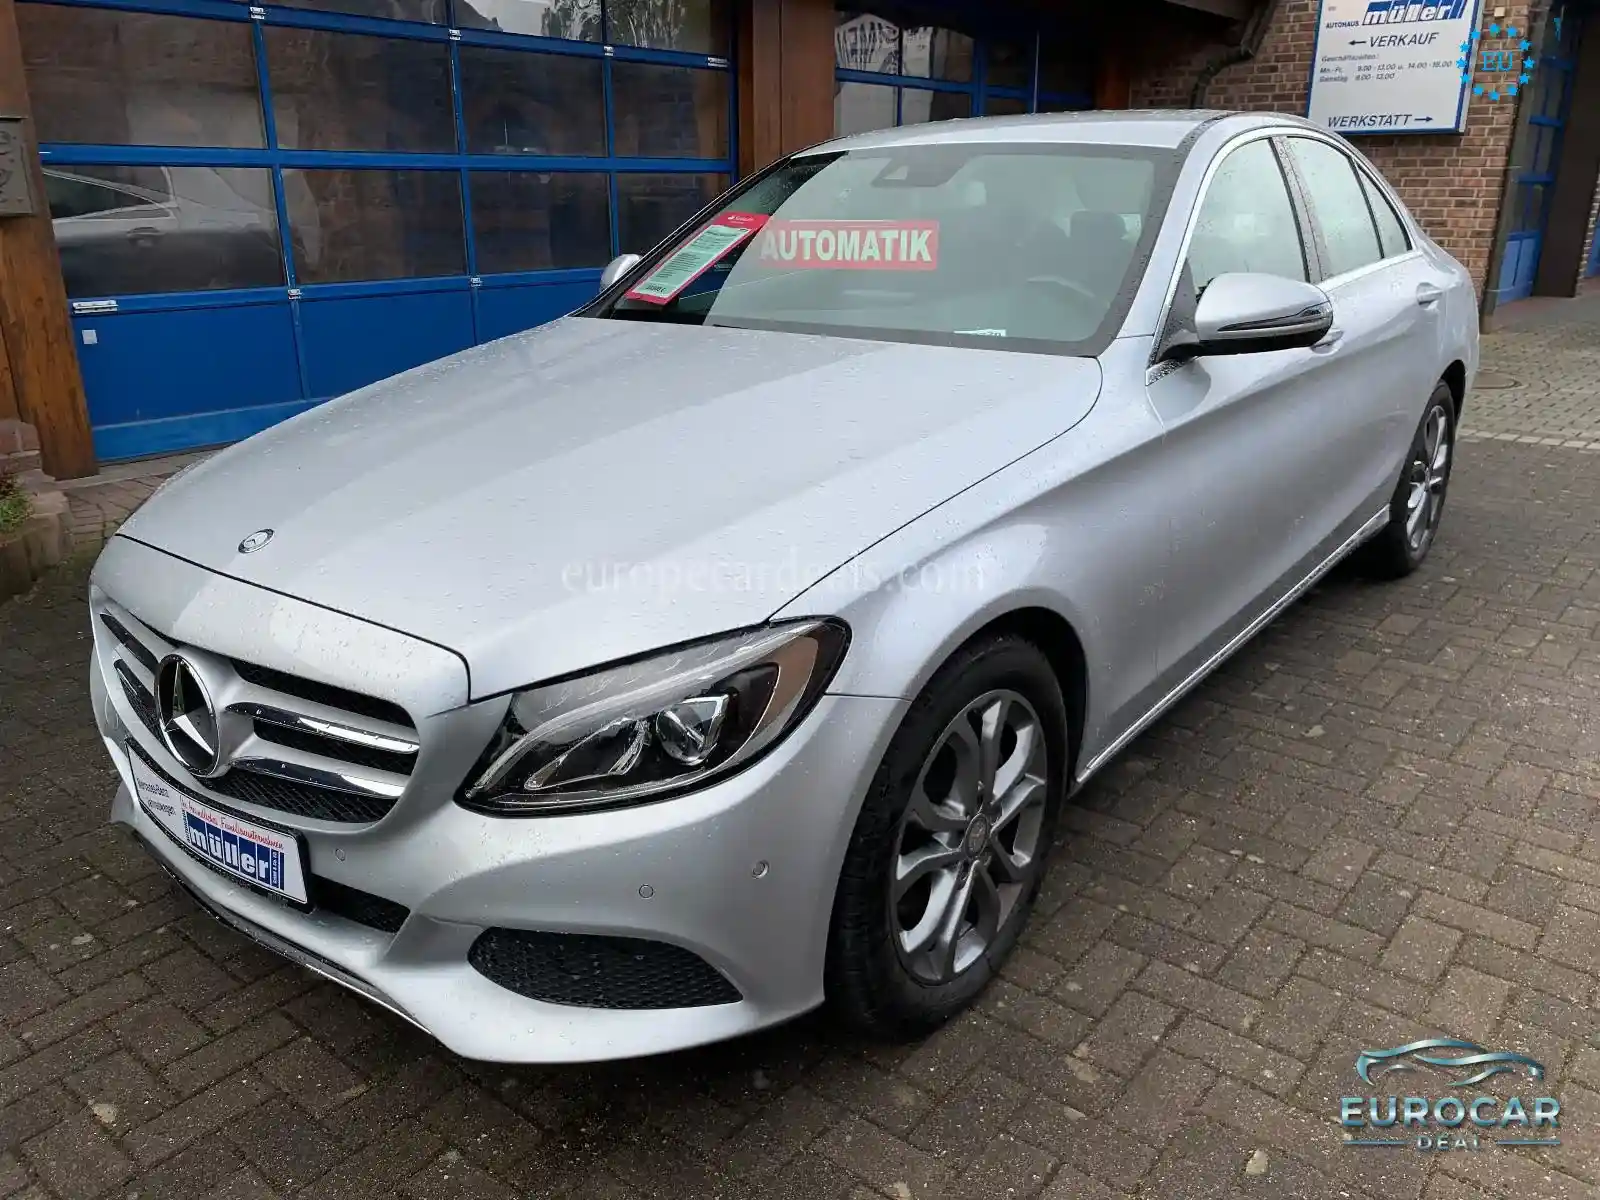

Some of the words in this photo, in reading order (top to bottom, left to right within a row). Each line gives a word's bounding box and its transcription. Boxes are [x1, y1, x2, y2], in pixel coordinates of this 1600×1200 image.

[1326, 20, 1360, 29] AUTOHAUS
[1362, 3, 1451, 26] müller
[1369, 32, 1439, 47] VERKAUF
[1327, 114, 1412, 128] WERKSTATT
[760, 229, 933, 262] AUTOMATIK
[188, 823, 269, 879] müller
